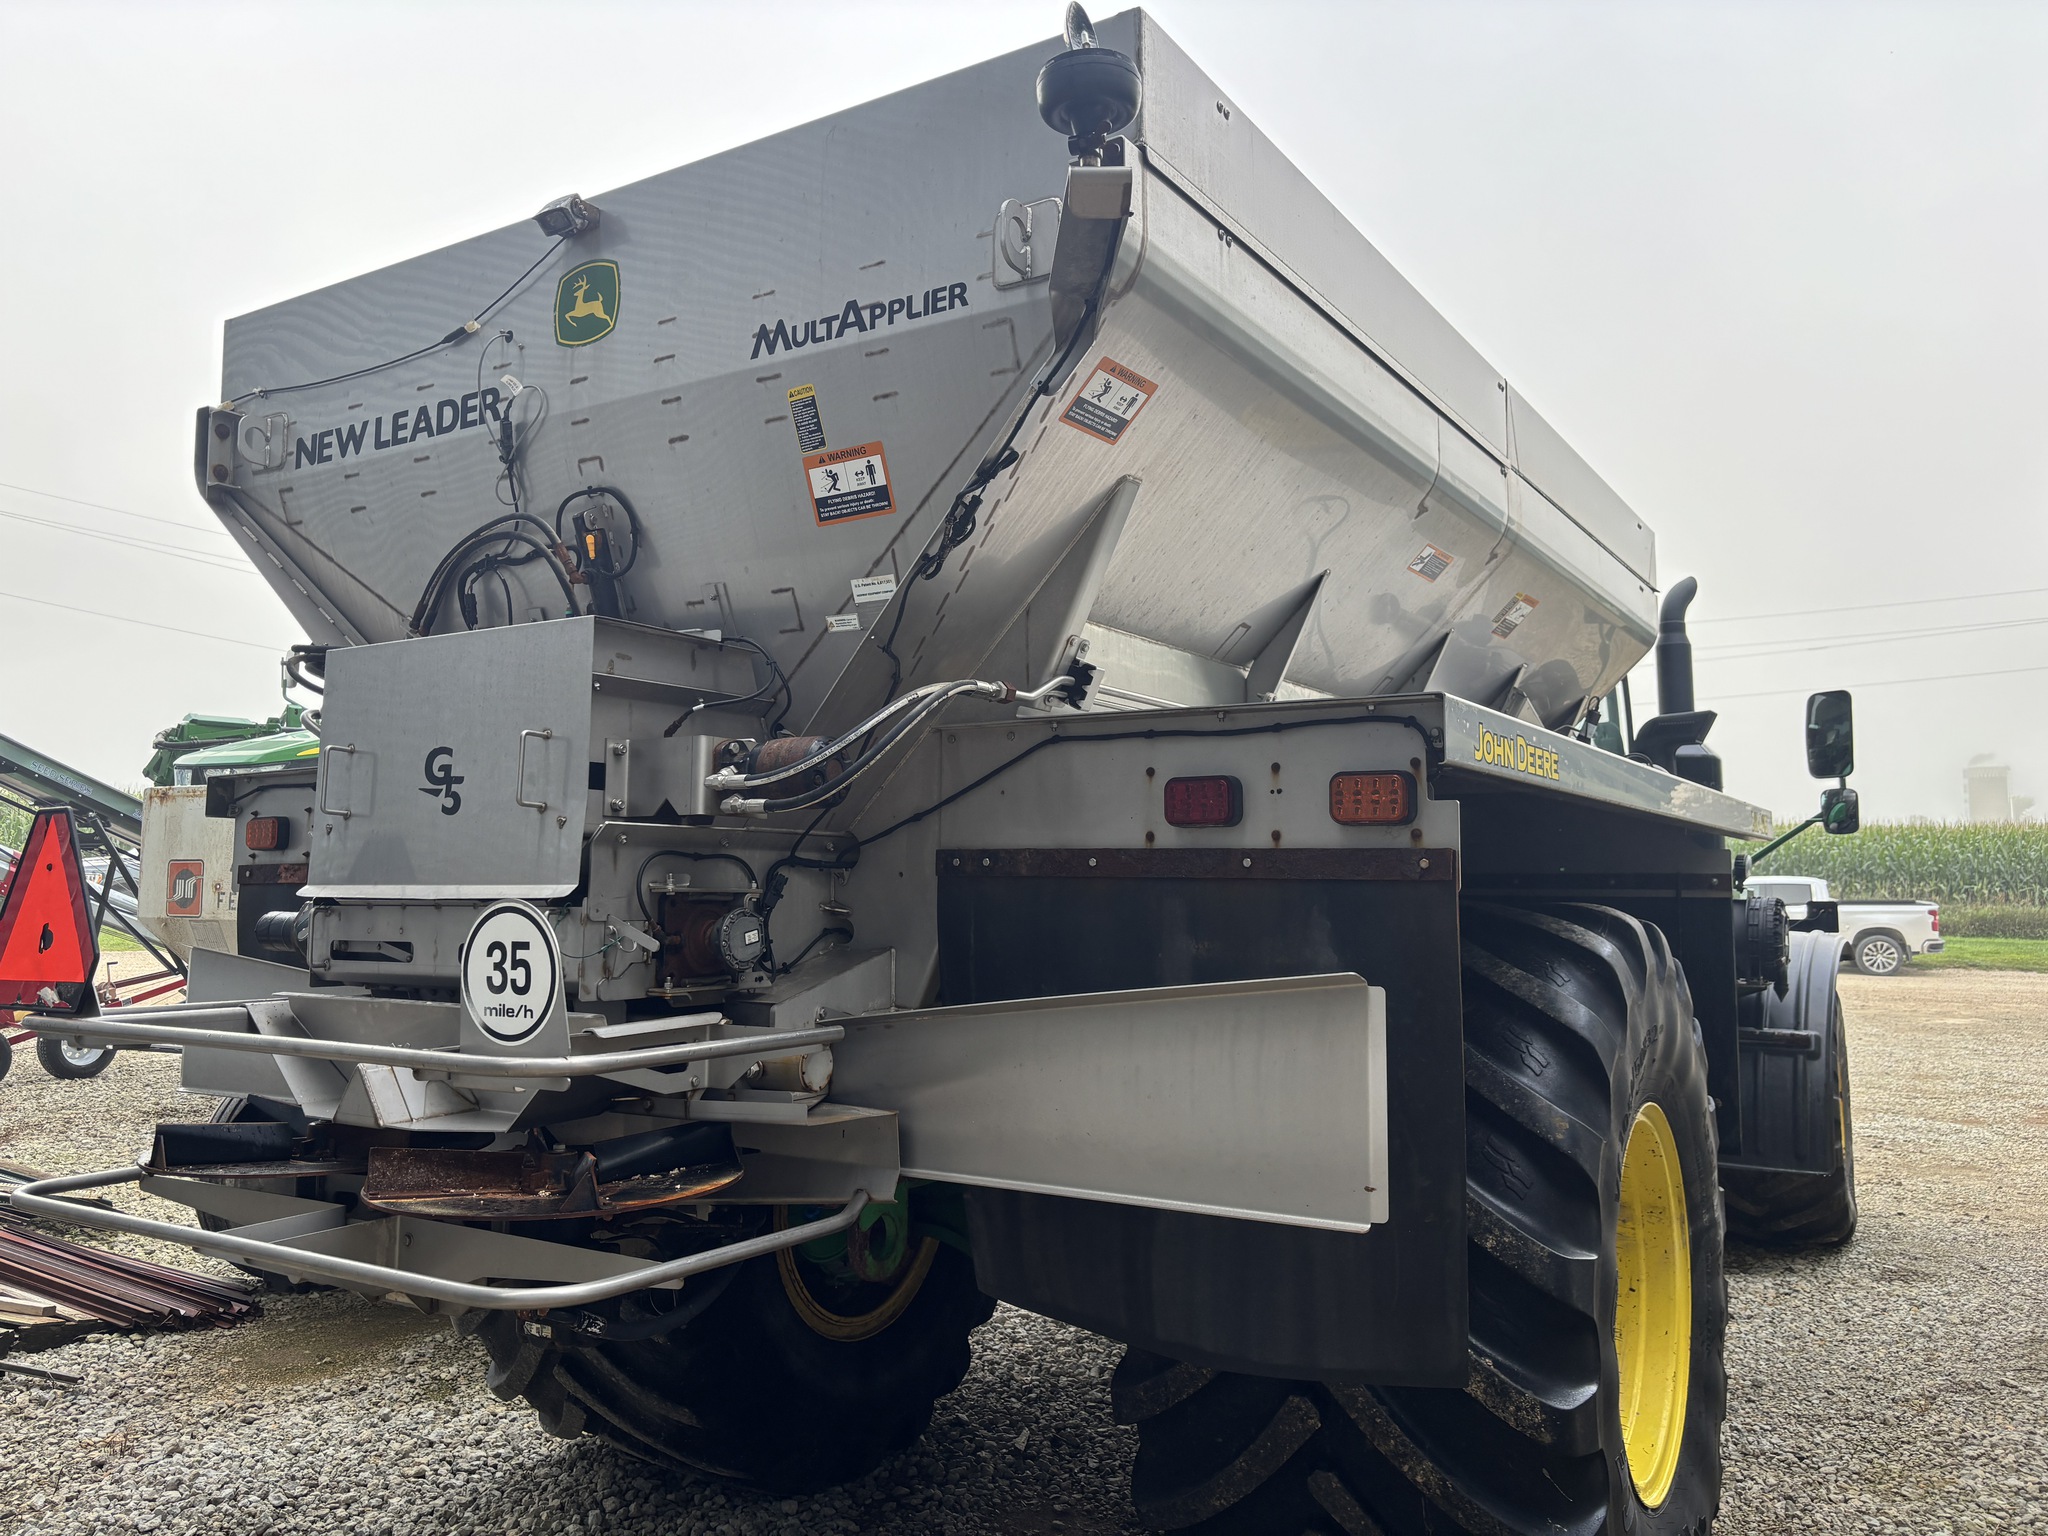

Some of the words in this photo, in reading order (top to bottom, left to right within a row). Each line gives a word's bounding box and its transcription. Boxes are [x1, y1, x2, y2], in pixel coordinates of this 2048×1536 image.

[1116, 367, 1147, 388] WARNING
[794, 386, 813, 397] CAUTION
[295, 419, 369, 470] NEW
[374, 387, 501, 451] LEADER
[827, 446, 867, 462] WARNING
[828, 496, 842, 505] FLYING
[843, 493, 857, 502] DEBRIS
[1474, 721, 1515, 770] JOHN
[1516, 733, 1559, 781] DEERE
[486, 940, 532, 996] 35
[483, 1004, 534, 1020] mile/h
